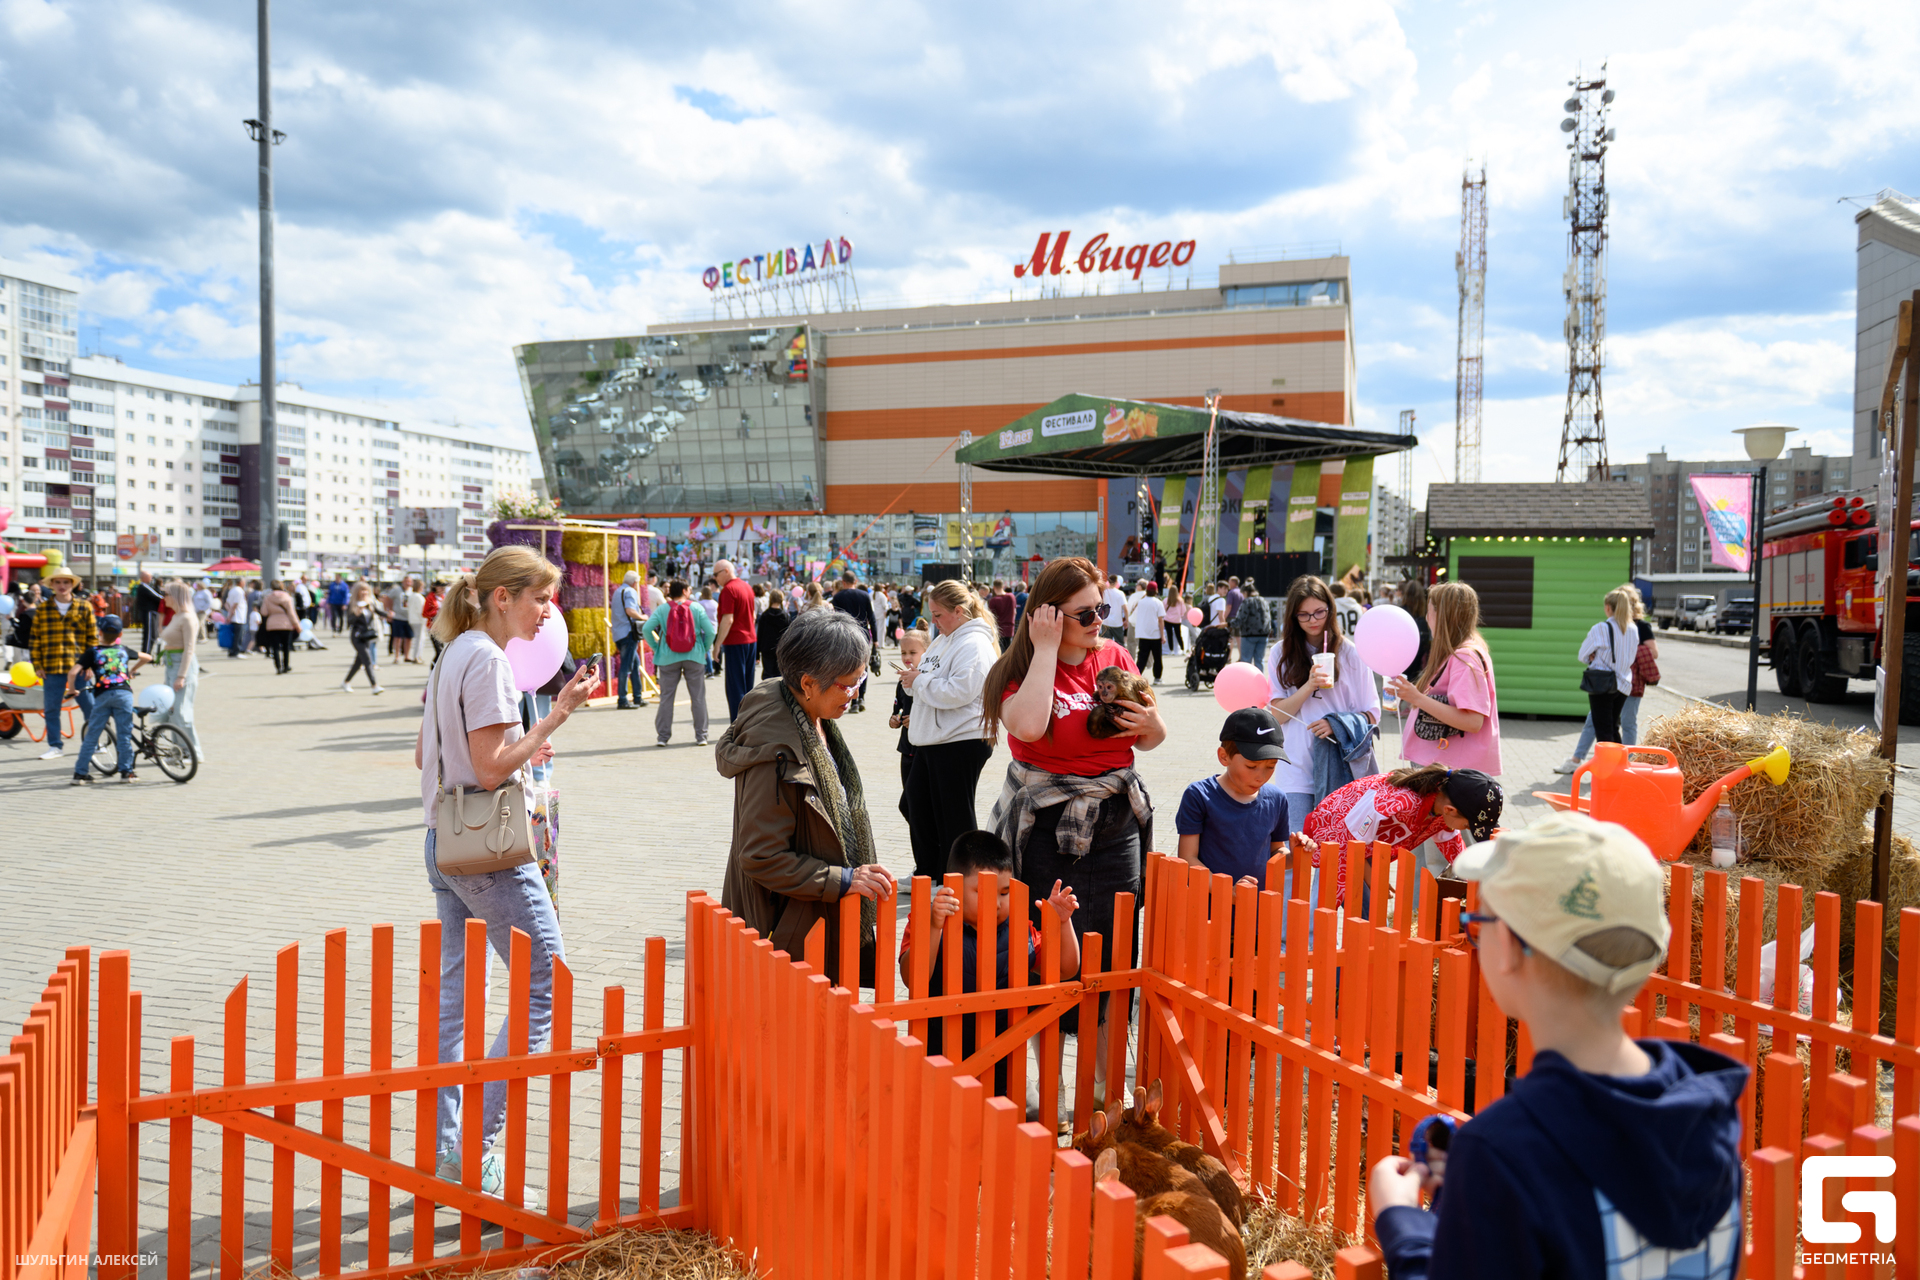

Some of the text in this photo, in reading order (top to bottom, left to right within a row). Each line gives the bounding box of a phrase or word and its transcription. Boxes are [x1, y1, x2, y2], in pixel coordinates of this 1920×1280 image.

[703, 236, 853, 291] ФЕСТИВАЛЬ
[1045, 413, 1093, 429] ФЕСТИВАЛЬ
[1000, 430, 1014, 449] 12
[1014, 428, 1034, 446] лет
